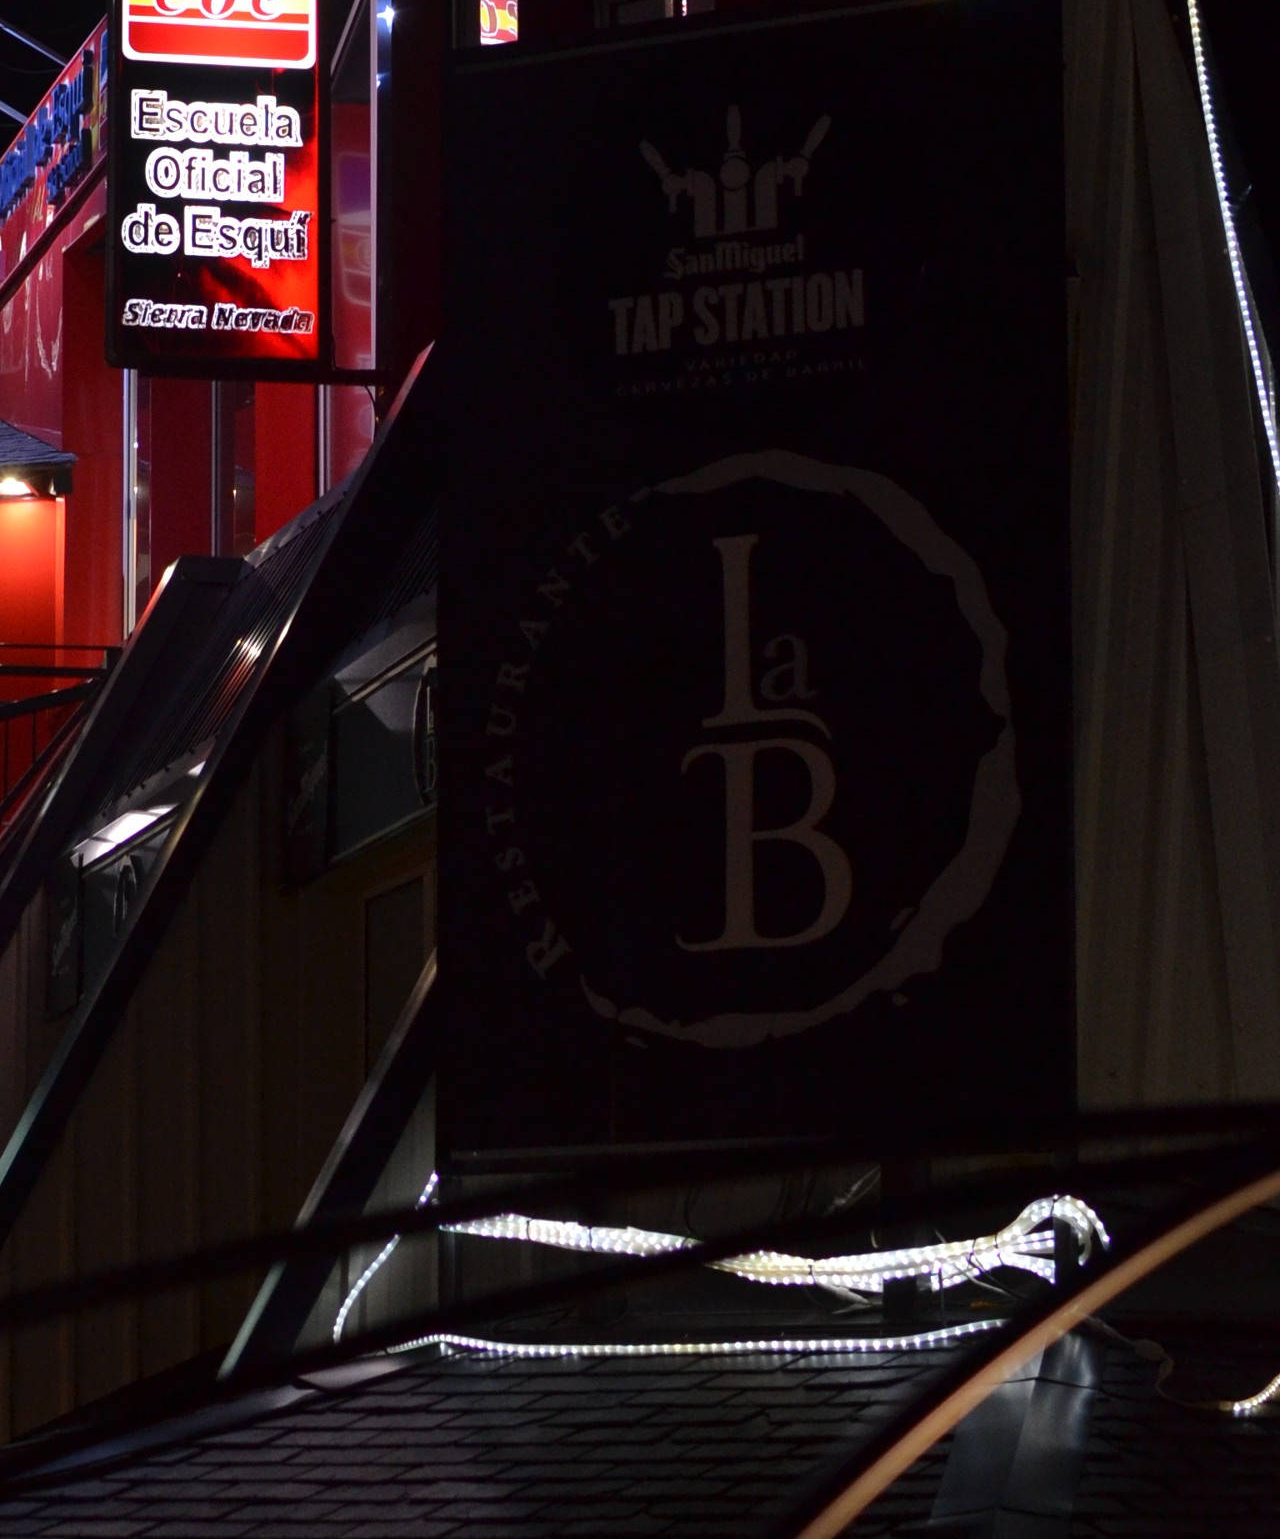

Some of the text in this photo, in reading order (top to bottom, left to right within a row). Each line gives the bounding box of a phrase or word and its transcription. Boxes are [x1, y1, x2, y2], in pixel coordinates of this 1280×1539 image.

[133, 92, 299, 144] Escuela
[147, 149, 283, 201] Oficial
[123, 205, 311, 266] de Esquí
[123, 299, 313, 333] Sierra Nevada
[608, 268, 866, 355] TAP STATION
[483, 503, 631, 978] RESTAURANTE
[674, 736, 855, 952] B
